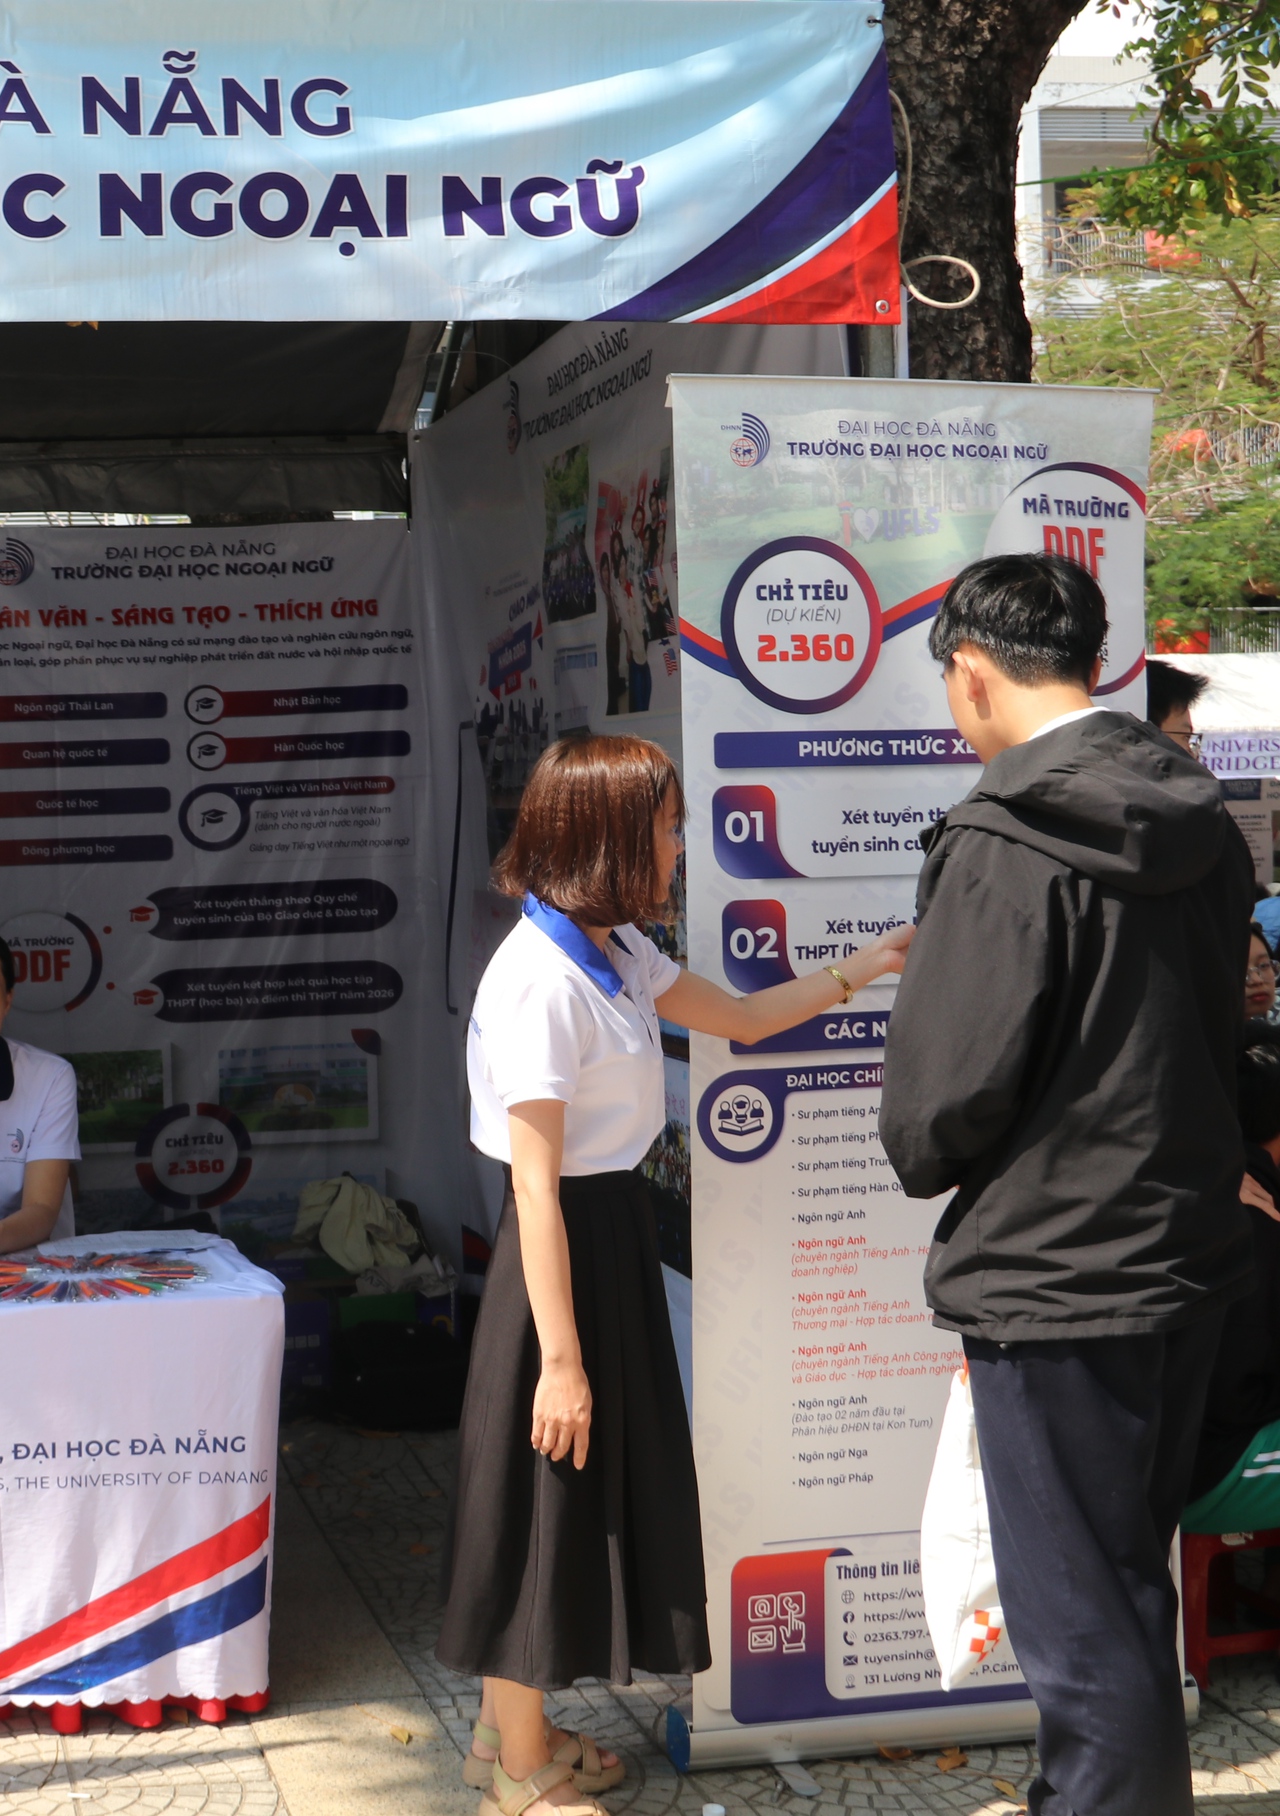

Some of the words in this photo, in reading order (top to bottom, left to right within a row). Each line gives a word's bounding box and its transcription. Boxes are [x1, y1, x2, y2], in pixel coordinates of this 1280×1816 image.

[82, 51, 350, 136] NẴNG
[99, 172, 407, 256] NGOẠI
[442, 159, 644, 237] NGỮ
[837, 419, 868, 436] ĐẠI
[873, 421, 913, 439] HỌC
[915, 418, 943, 436] ĐÀ
[947, 417, 997, 440] NẴNG
[786, 438, 865, 457] TRƯỜNG
[869, 443, 901, 461] ĐẠI
[906, 443, 947, 461] HỌC
[952, 443, 1008, 463] NGOẠI
[1013, 443, 1049, 461] NGỮ
[1022, 494, 1050, 515] MÃ
[1054, 496, 1129, 518] TRƯỜNG
[104, 546, 138, 562] ĐẠI
[143, 545, 186, 561] HỌC
[189, 541, 217, 558] ĐÀ
[222, 539, 277, 557] NẴNG
[50, 561, 133, 581] TRƯỜNG
[137, 563, 173, 581] ĐẠI
[177, 563, 220, 580] HỌC
[225, 561, 287, 578] NGOẠI
[291, 555, 335, 574] NGỮ
[755, 579, 795, 601] CHỈ
[797, 579, 849, 601] TIÊU
[38, 605, 88, 628] VĂN
[111, 605, 175, 627] SÁNG
[181, 605, 232, 626] TẠO
[253, 601, 323, 622] THÍCH
[330, 598, 379, 619] ỨNG
[766, 606, 798, 626] (DỰ
[799, 603, 842, 625] KIẾN)
[758, 634, 854, 662] 2.360
[798, 737, 884, 757] PHƯƠNG
[887, 734, 947, 756] THỨC
[725, 811, 764, 842] 01
[841, 808, 870, 825] Xét
[872, 805, 924, 828] tuyển
[730, 927, 778, 959] 02
[823, 1017, 867, 1040] CÁC
[785, 1073, 813, 1090] ĐẠI
[816, 1070, 851, 1088] HỌC
[12, 1442, 56, 1464] ĐẠI
[66, 1439, 121, 1462] HỌC
[128, 1433, 167, 1456] ĐÀ
[176, 1430, 245, 1454] NẴNG
[13, 1475, 50, 1491] THE
[56, 1471, 163, 1489] UNIVERSITY
[167, 1471, 193, 1485] OF
[198, 1469, 269, 1487] DANANG
